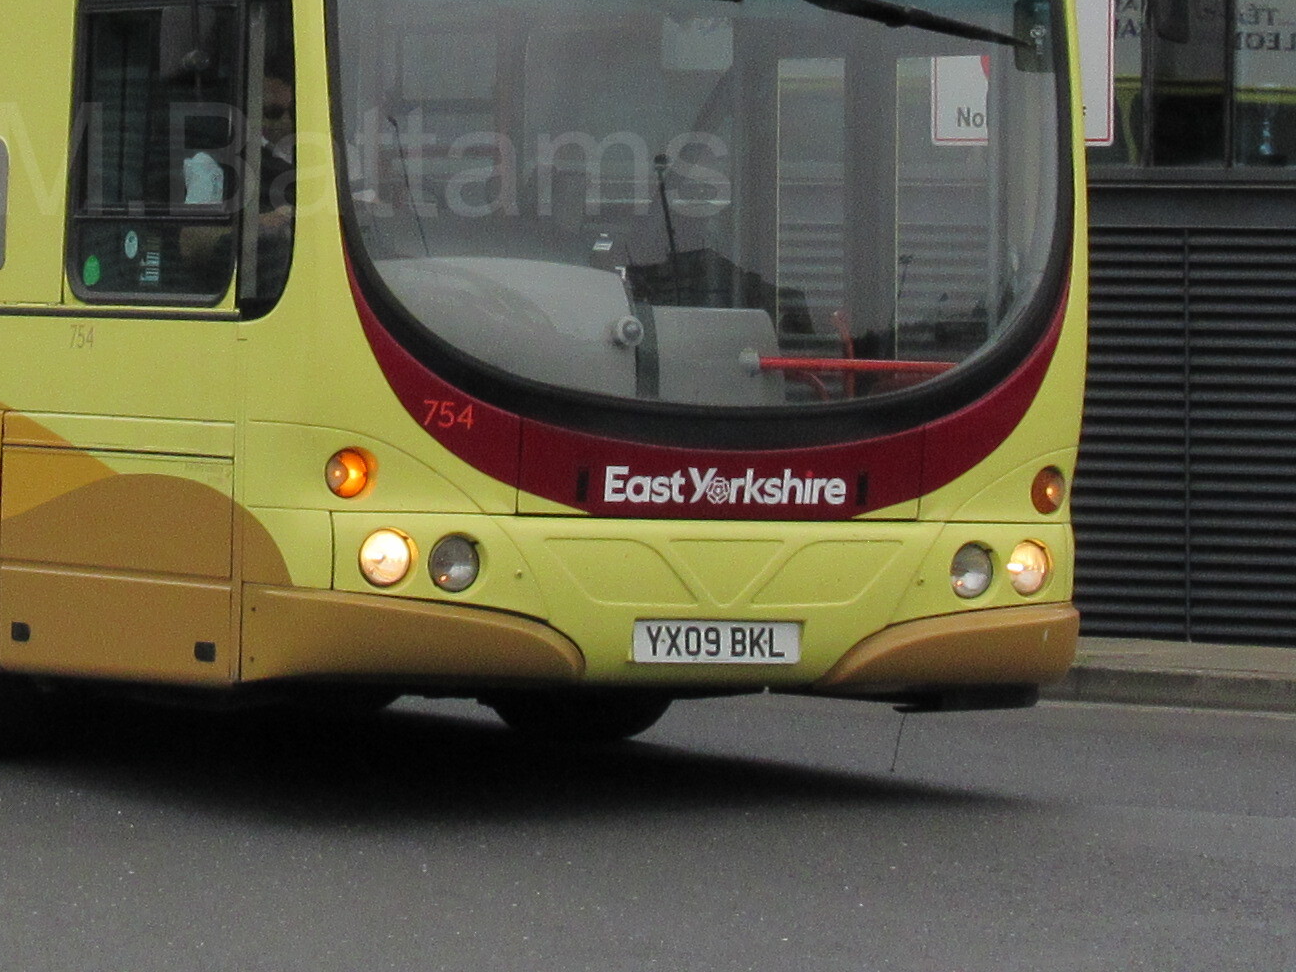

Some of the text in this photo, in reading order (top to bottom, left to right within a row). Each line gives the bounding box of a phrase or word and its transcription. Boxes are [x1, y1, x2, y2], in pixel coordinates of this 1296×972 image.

[957, 107, 985, 128] No
[70, 324, 95, 348] 754
[423, 399, 475, 430] 754
[645, 625, 785, 658] YX09 BKL
